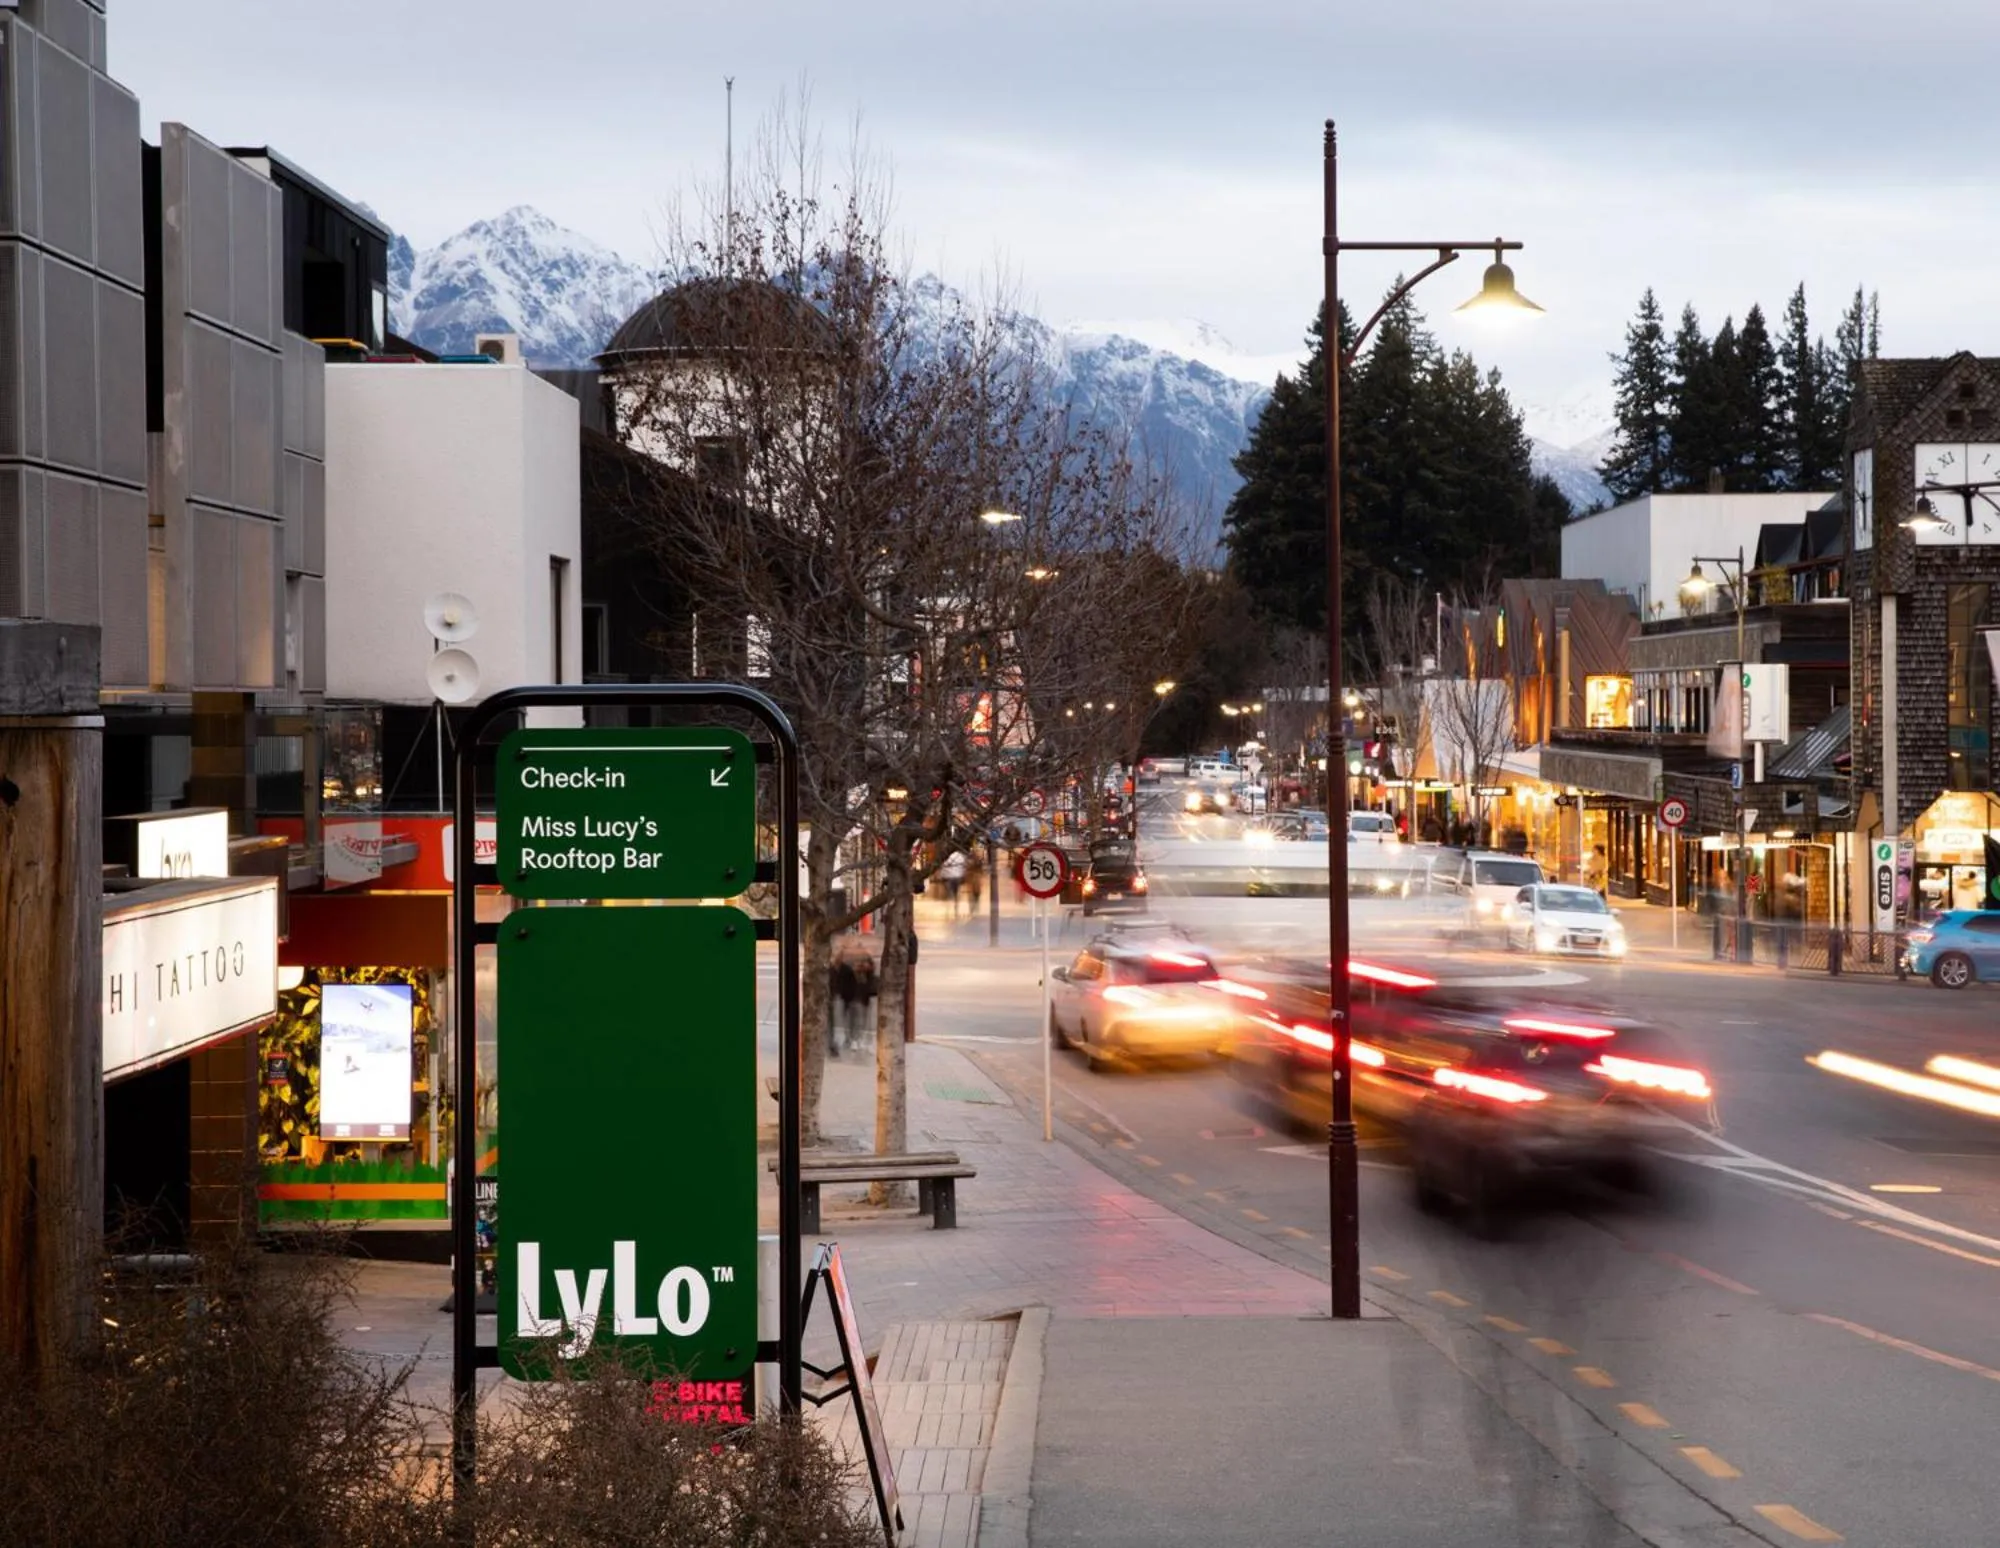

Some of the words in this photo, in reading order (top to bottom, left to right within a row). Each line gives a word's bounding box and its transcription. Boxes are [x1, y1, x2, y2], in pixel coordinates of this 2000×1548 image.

[520, 766, 626, 789] Check-in
[1667, 806, 1683, 819] 40
[520, 815, 577, 838] Miss
[584, 815, 658, 842] Lucy’s
[520, 847, 616, 874] Rooftop
[623, 847, 664, 869] Bar
[1029, 860, 1055, 880] 50
[155, 940, 244, 1002] TATTOO
